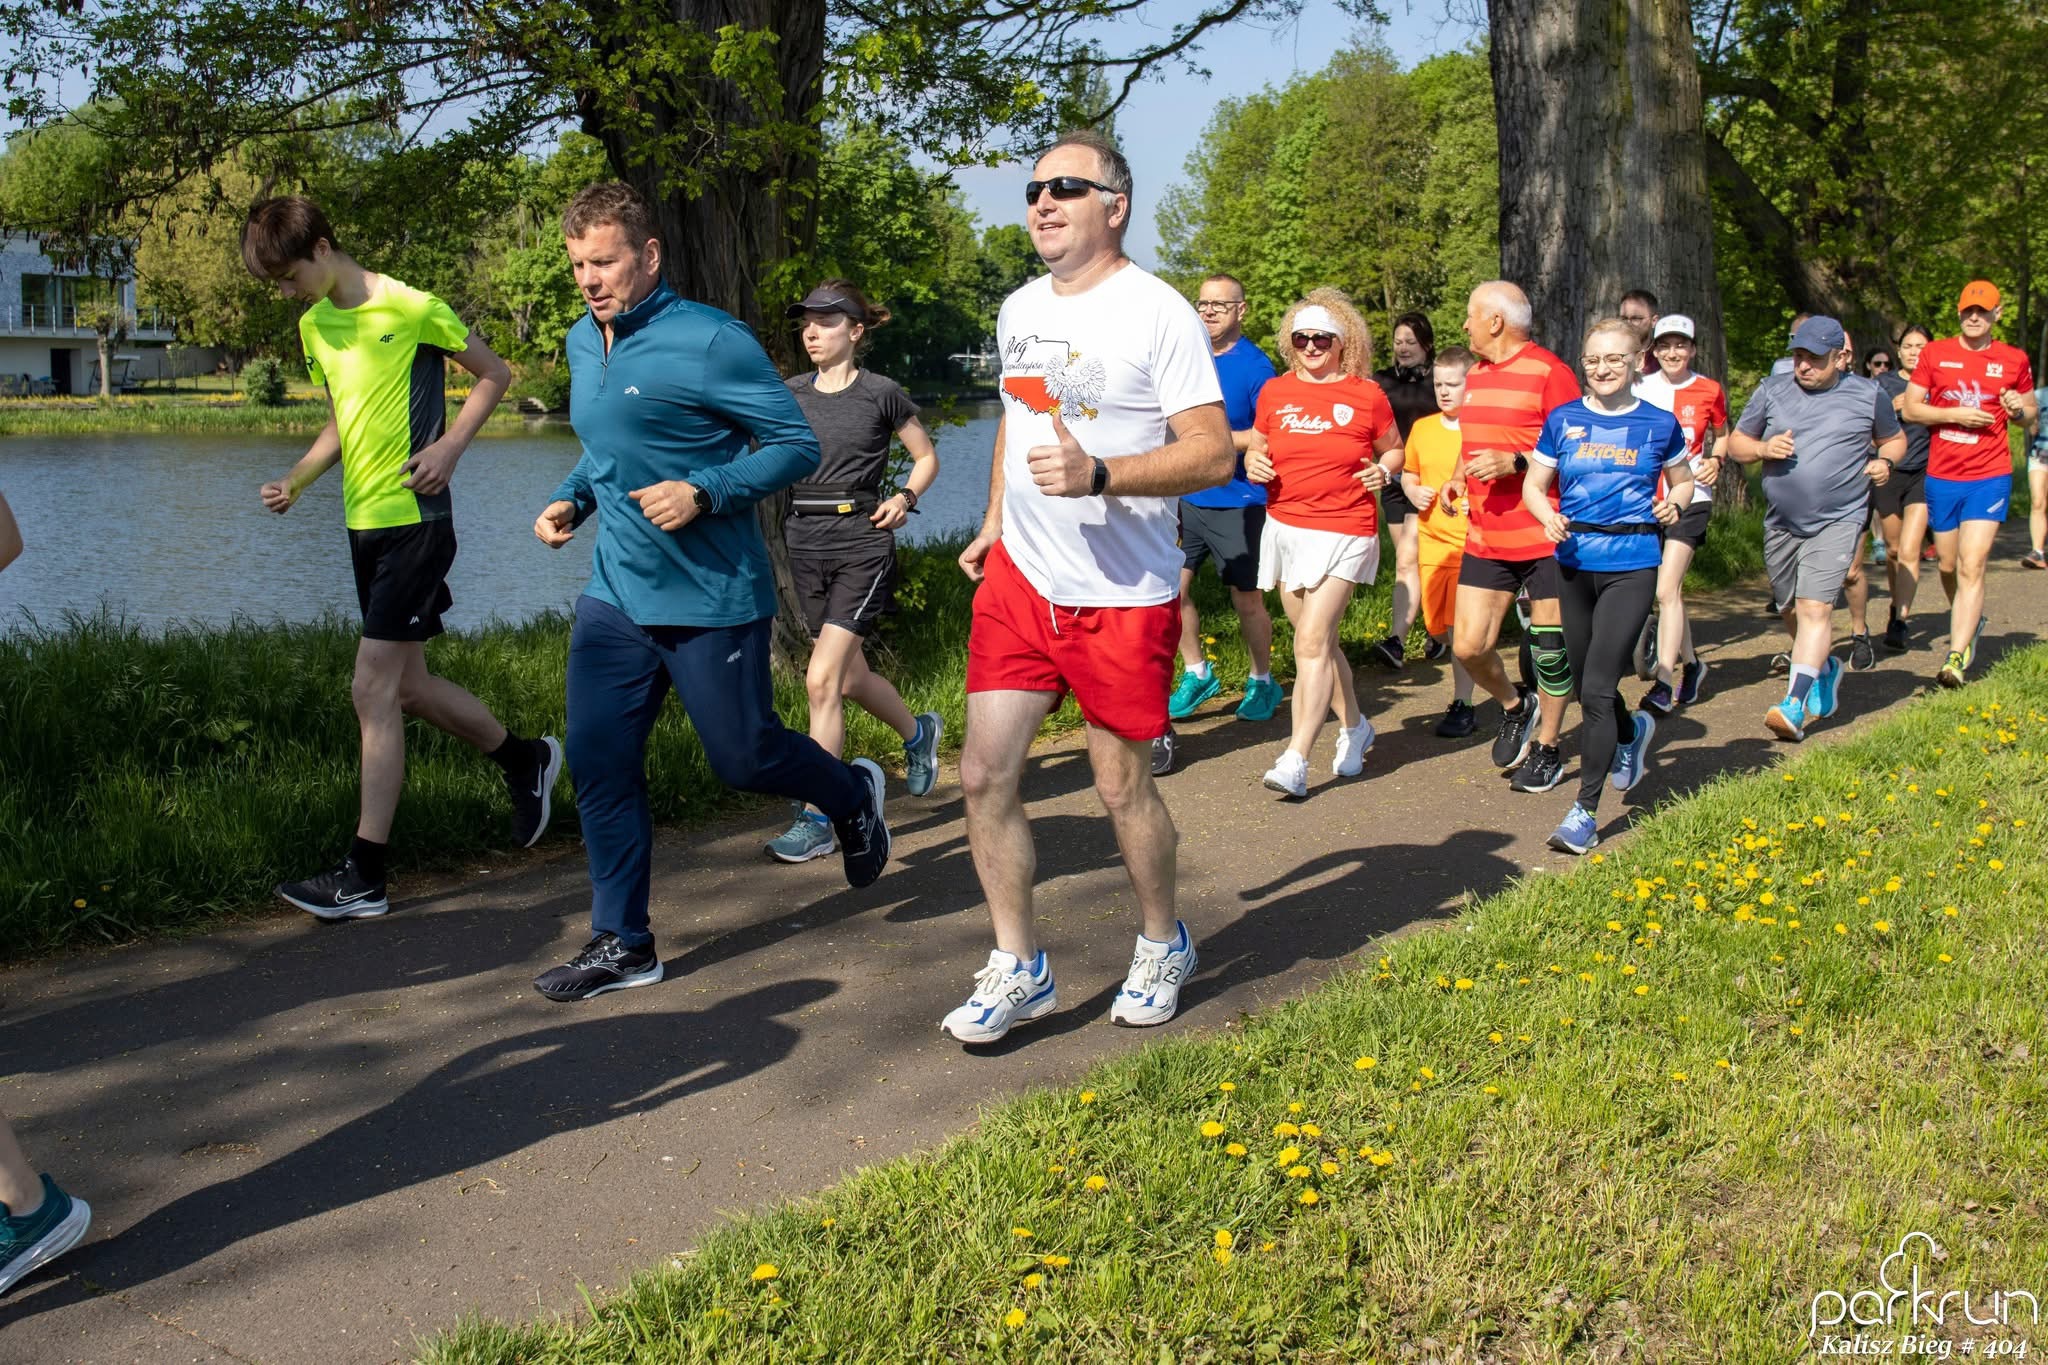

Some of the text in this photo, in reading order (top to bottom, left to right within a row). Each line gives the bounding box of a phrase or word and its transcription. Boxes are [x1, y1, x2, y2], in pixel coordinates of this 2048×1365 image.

[379, 334, 395, 344] 4F
[1279, 413, 1334, 431] Polska
[1576, 446, 1639, 460] EKIDEN
